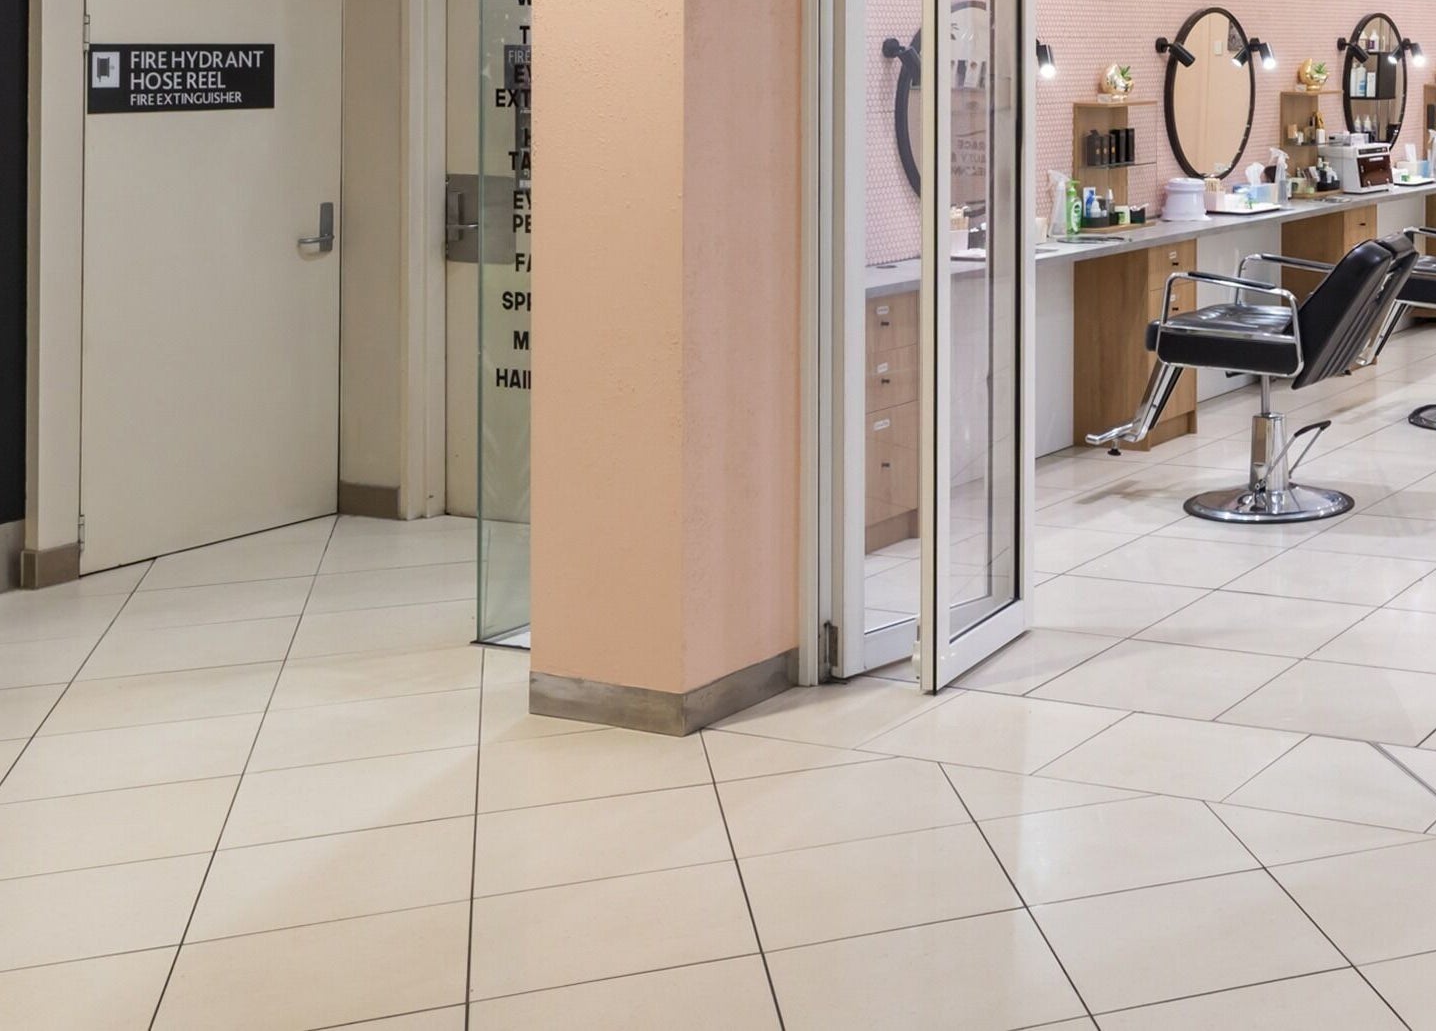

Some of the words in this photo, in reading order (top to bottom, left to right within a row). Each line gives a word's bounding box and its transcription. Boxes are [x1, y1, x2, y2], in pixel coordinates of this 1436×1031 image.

[130, 51, 168, 69] FIRE
[171, 51, 265, 69] HYDRANT
[130, 72, 183, 90] HOSE
[187, 71, 227, 89] REEL
[130, 93, 155, 106] FIRE
[157, 91, 243, 106] EXTINGUISHER
